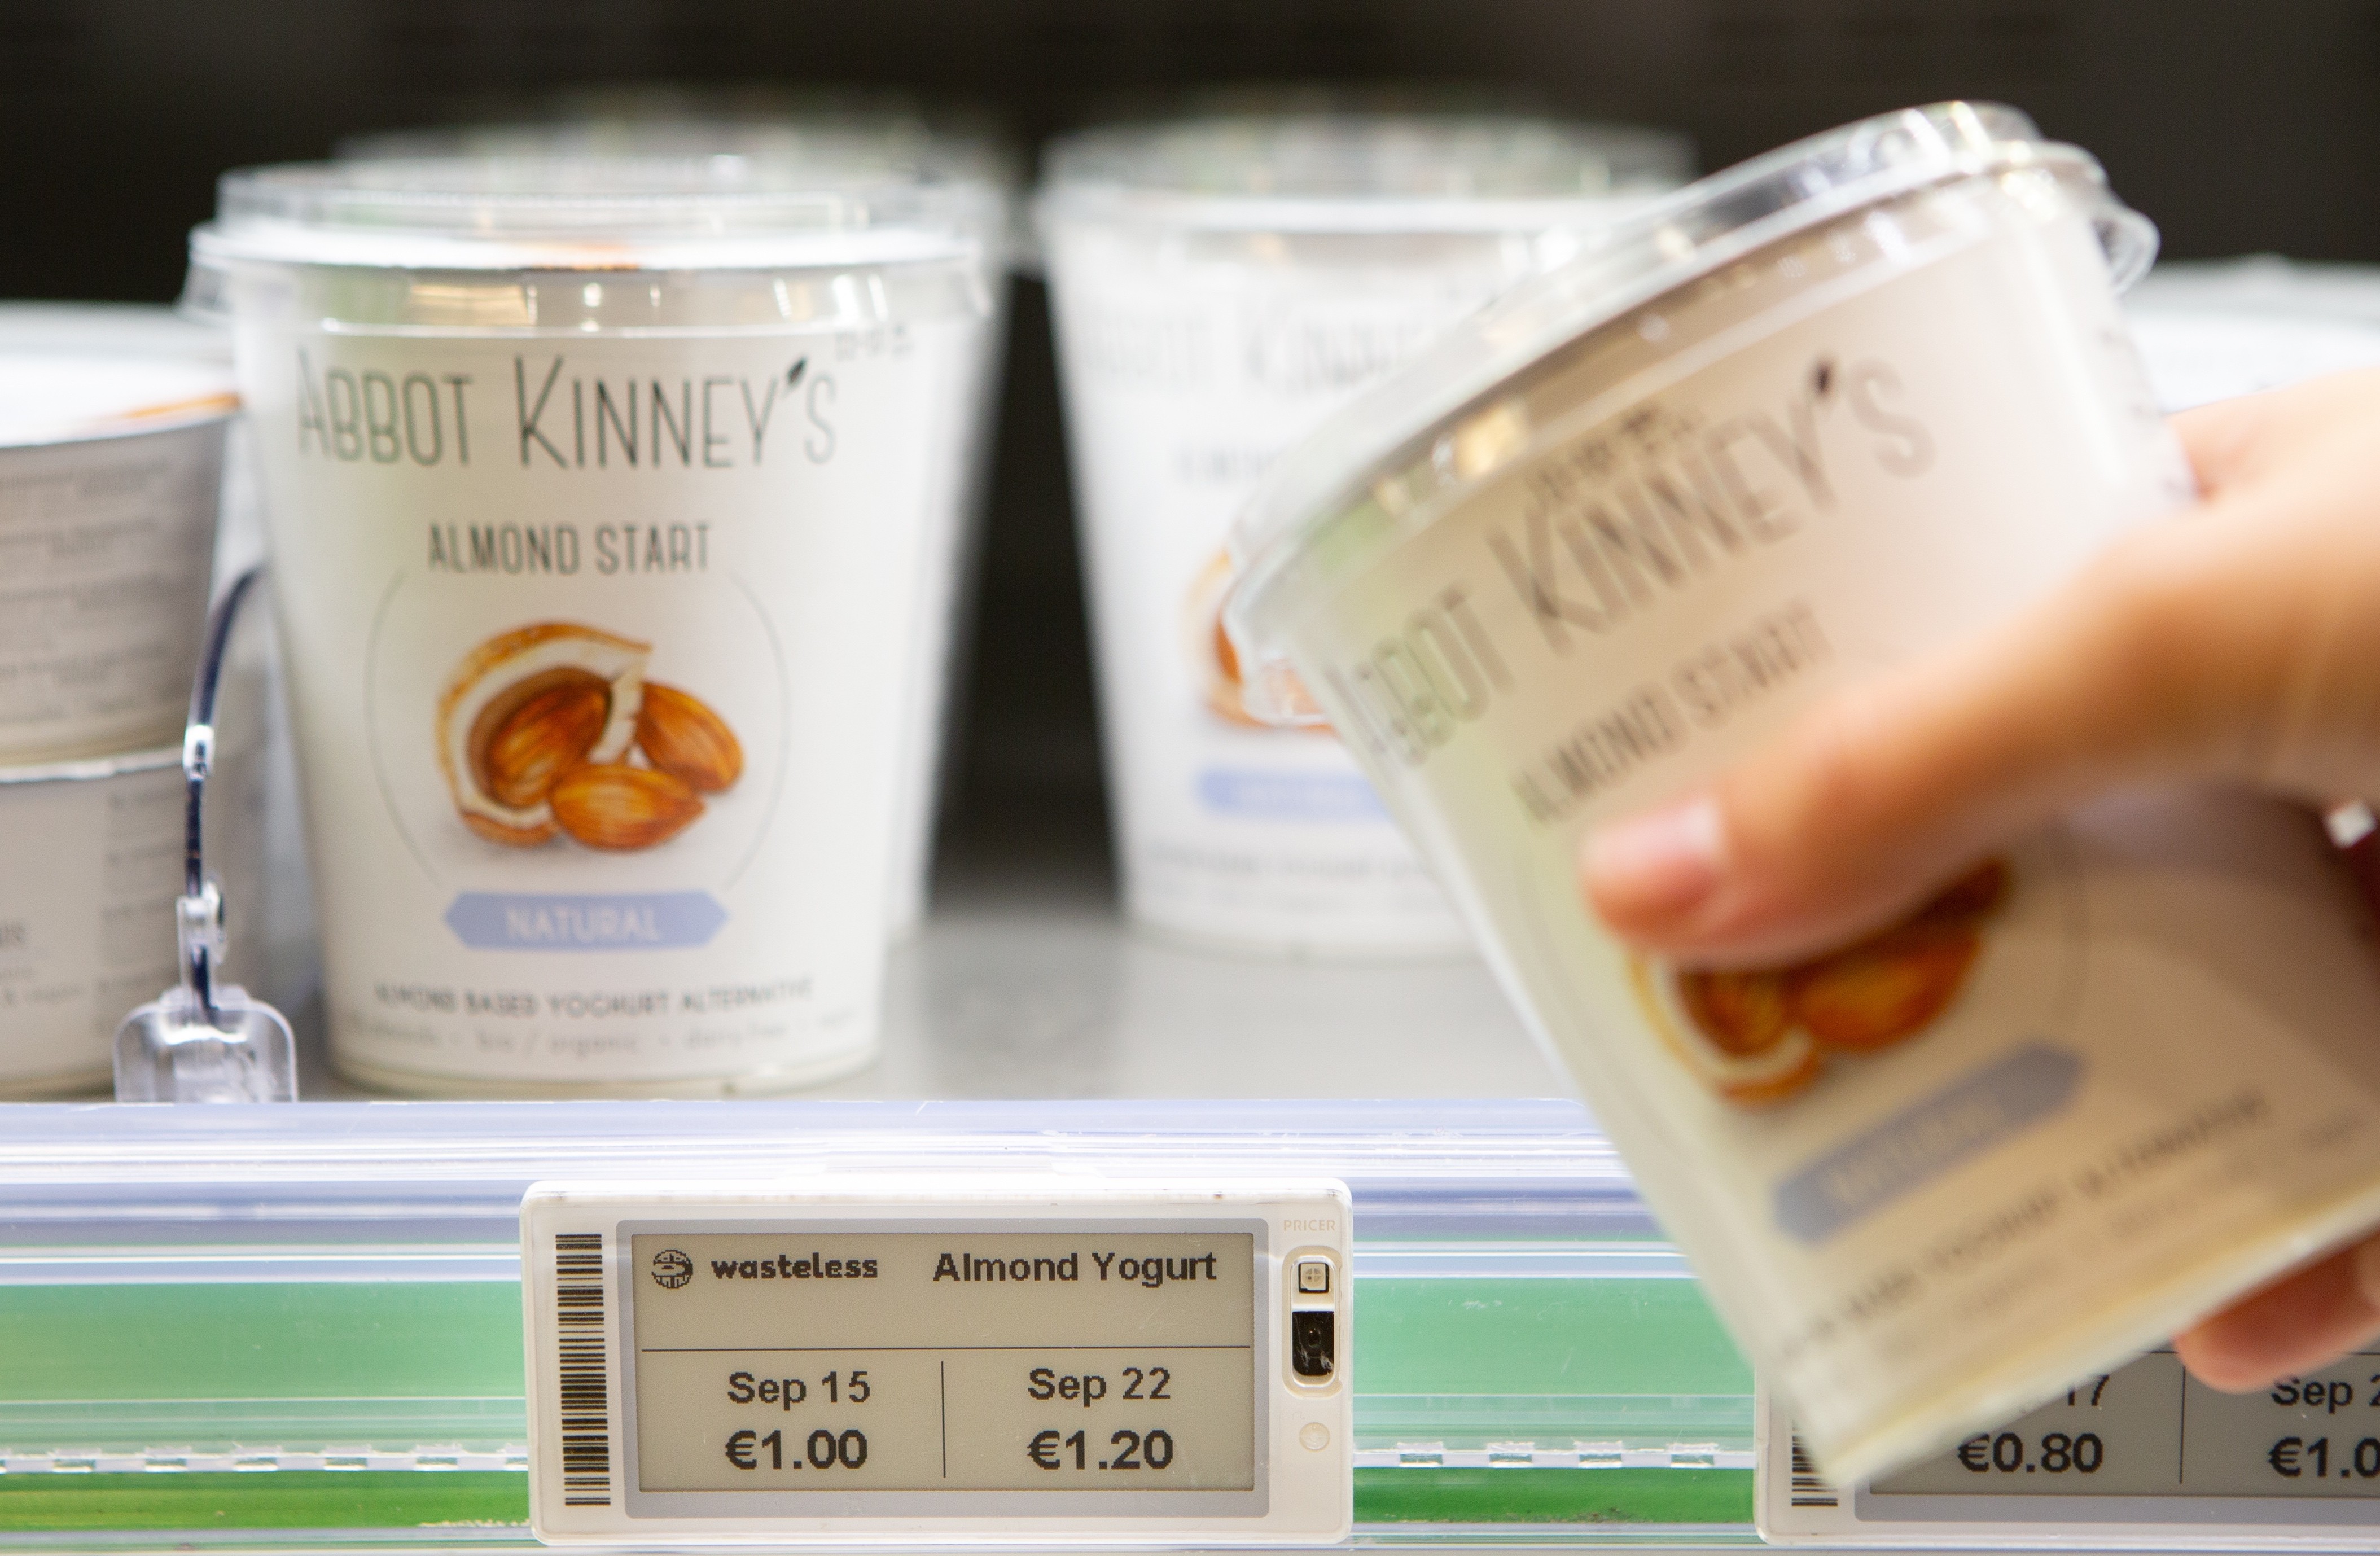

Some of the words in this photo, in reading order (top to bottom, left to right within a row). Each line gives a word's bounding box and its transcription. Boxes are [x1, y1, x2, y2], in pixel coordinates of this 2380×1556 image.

[296, 346, 474, 466] ABBOT
[514, 353, 839, 470] KINNEY'S
[428, 521, 580, 575] ALMOND
[594, 522, 712, 575] START
[505, 904, 664, 943] NATURAL
[1283, 1220, 1335, 1231] PRICER
[711, 1252, 878, 1279] wasteless
[933, 1252, 1079, 1282] Almond
[1092, 1251, 1217, 1289] Yogurt
[727, 1371, 807, 1412] Sep
[822, 1371, 870, 1403] 15
[1028, 1367, 1107, 1408] Sep
[1122, 1367, 1171, 1400] 22
[2271, 1375, 2354, 1415] Sep
[725, 1429, 868, 1470] €1.00
[1027, 1430, 1174, 1470] €1.20
[1957, 1432, 2103, 1474] €0.80
